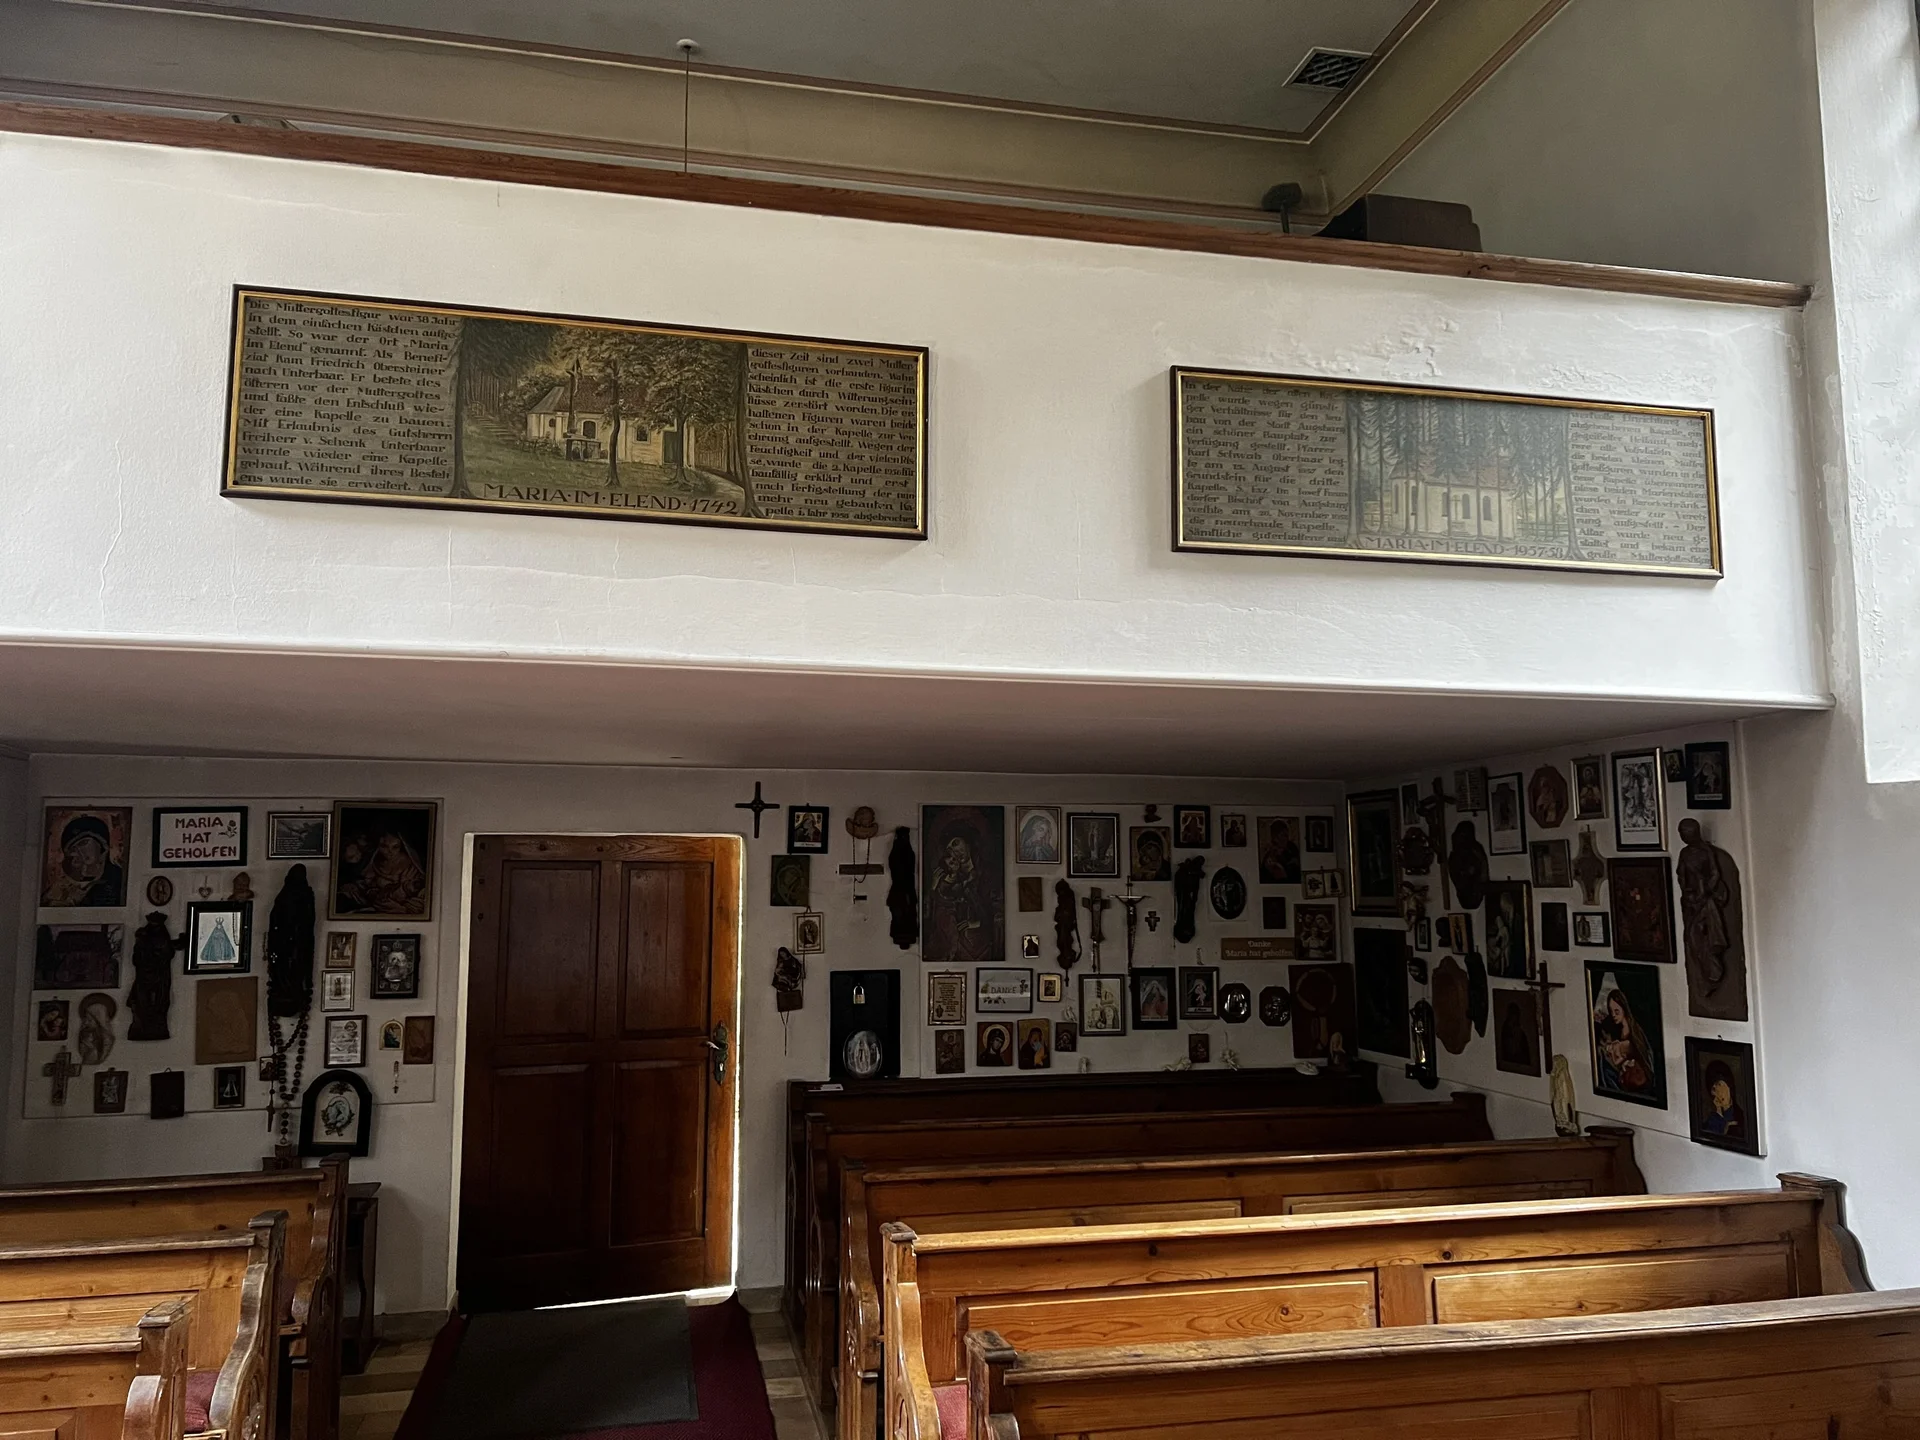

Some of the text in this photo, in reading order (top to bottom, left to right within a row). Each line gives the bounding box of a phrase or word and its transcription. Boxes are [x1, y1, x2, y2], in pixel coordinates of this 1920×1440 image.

[249, 301, 269, 310] Die
[249, 314, 418, 335] in dem einfachen Kästchen
[248, 327, 281, 337] stellt.
[289, 330, 302, 338] So
[346, 335, 368, 343] der
[379, 337, 398, 346] Ort
[309, 345, 366, 358] genannt.
[373, 350, 392, 358] Als
[405, 352, 447, 362] Benefi-
[751, 347, 873, 366] dieser Zeit sind zwei
[311, 358, 364, 369] Friedrich
[373, 362, 445, 375] Obersteiner
[750, 360, 882, 379] gottesfiguren vorhanden.
[244, 366, 440, 387] nach Unterbaar. Er betete des
[749, 371, 796, 383] scheinlich
[805, 376, 817, 385] ist
[825, 378, 841, 387] die
[849, 380, 873, 390] erste
[244, 379, 288, 389] öfteren
[327, 385, 348, 393] der
[357, 387, 440, 401] Muttergottes
[748, 384, 828, 398] Kästchen durch
[244, 393, 444, 413] und faßte den Entschluß wie-
[747, 396, 776, 406] flüsse
[783, 398, 827, 410] zerstört
[881, 406, 897, 415] Die
[1218, 394, 1293, 409] wurde wegen
[243, 406, 265, 415] der
[274, 408, 302, 417] eine
[315, 411, 361, 423] Kapelle
[747, 408, 794, 420] haltenen
[802, 412, 842, 425] Figuren
[850, 418, 885, 426] waren
[1238, 418, 1256, 426] der
[243, 419, 451, 439] Mit Erlaubnis des Gutsherrn
[749, 420, 894, 439] schon in der Kapelle zur
[1213, 427, 1255, 437] schöner
[1262, 430, 1308, 442] Bauplatz
[242, 433, 296, 443] Freiherr
[320, 437, 366, 447] Schenk
[381, 441, 445, 452] Unterbaar
[748, 432, 914, 452] ehrung aufgestellt. Wegen der
[243, 446, 446, 467] wurde wieder eine Kapelle
[749, 444, 899, 462] Feuchtigkeit und der vielen
[240, 460, 403, 476] gebaut. Während ihres
[812, 460, 881, 475] die Kapelle
[1252, 463, 1290, 474] August
[1324, 467, 1343, 475] den
[270, 475, 311, 485] wurde
[319, 478, 337, 486] sie
[348, 479, 409, 489] erweitert.
[418, 483, 442, 491] Aus
[751, 469, 908, 486] baufällig erklärt und erst
[1254, 474, 1271, 482] für
[1279, 475, 1295, 483] die
[1309, 477, 1339, 485] dritte
[755, 481, 891, 497] nach Fertigstellung der
[758, 493, 892, 510] mehr neu gebauten
[1227, 495, 1263, 504] Bischof
[765, 505, 793, 517] pelle
[1278, 509, 1329, 518] November
[1616, 530, 1649, 539] wurde
[1620, 541, 1638, 549] und
[175, 817, 223, 829] MARIA
[182, 832, 212, 843] HAT
[163, 846, 237, 858] GEHOLFEN
[990, 986, 1017, 994] DANKE
